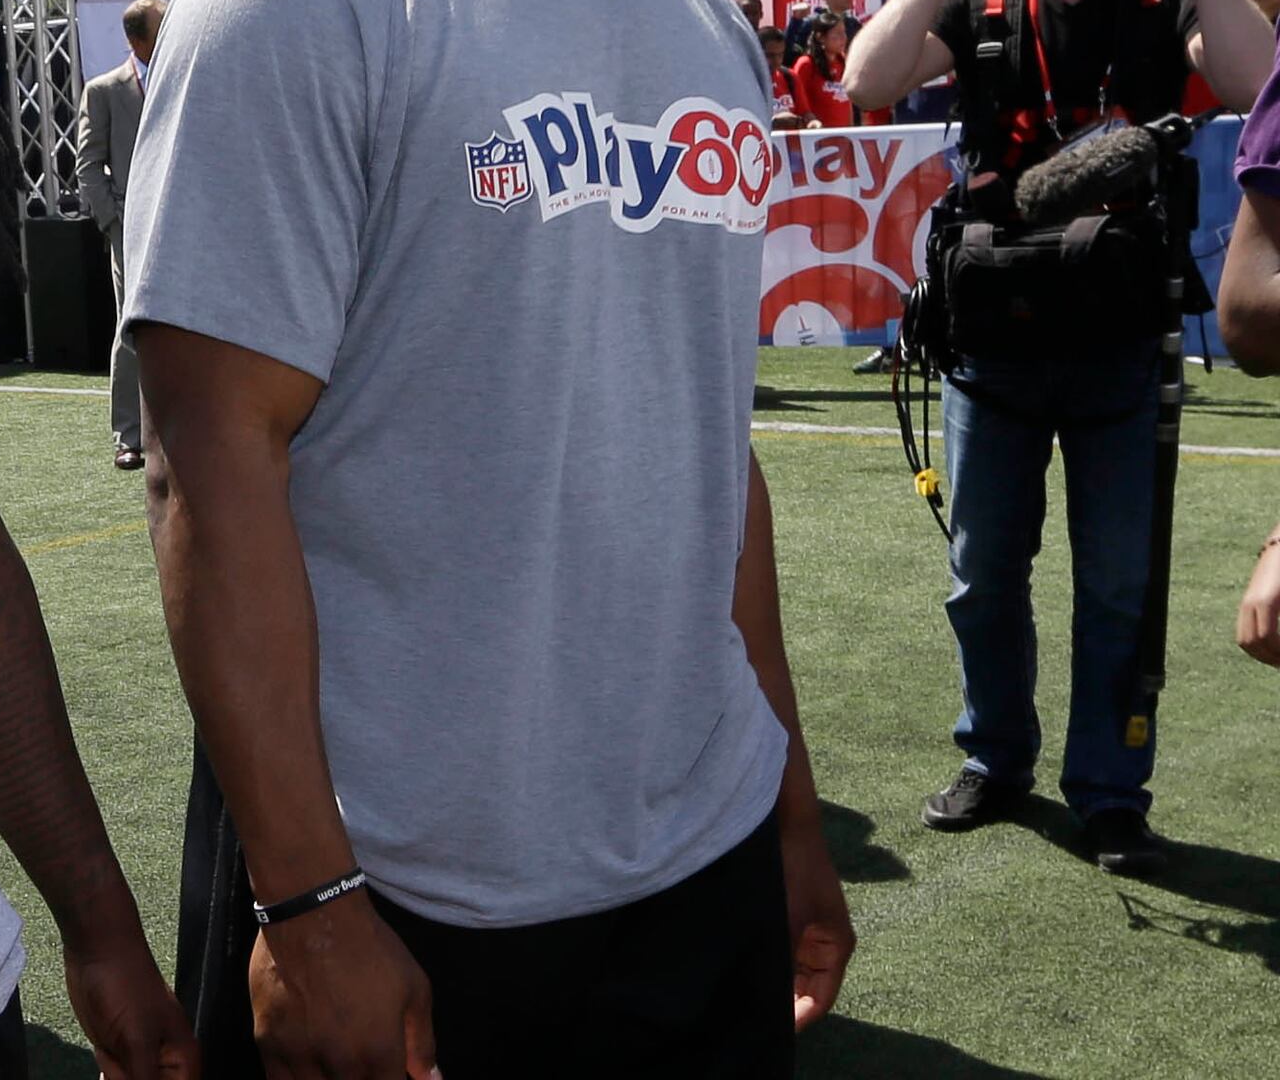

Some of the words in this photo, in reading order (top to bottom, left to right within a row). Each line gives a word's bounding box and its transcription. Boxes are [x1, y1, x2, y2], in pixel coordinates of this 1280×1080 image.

[477, 167, 525, 200] NFL
[661, 205, 687, 215] FOR
[692, 210, 709, 218] AN
